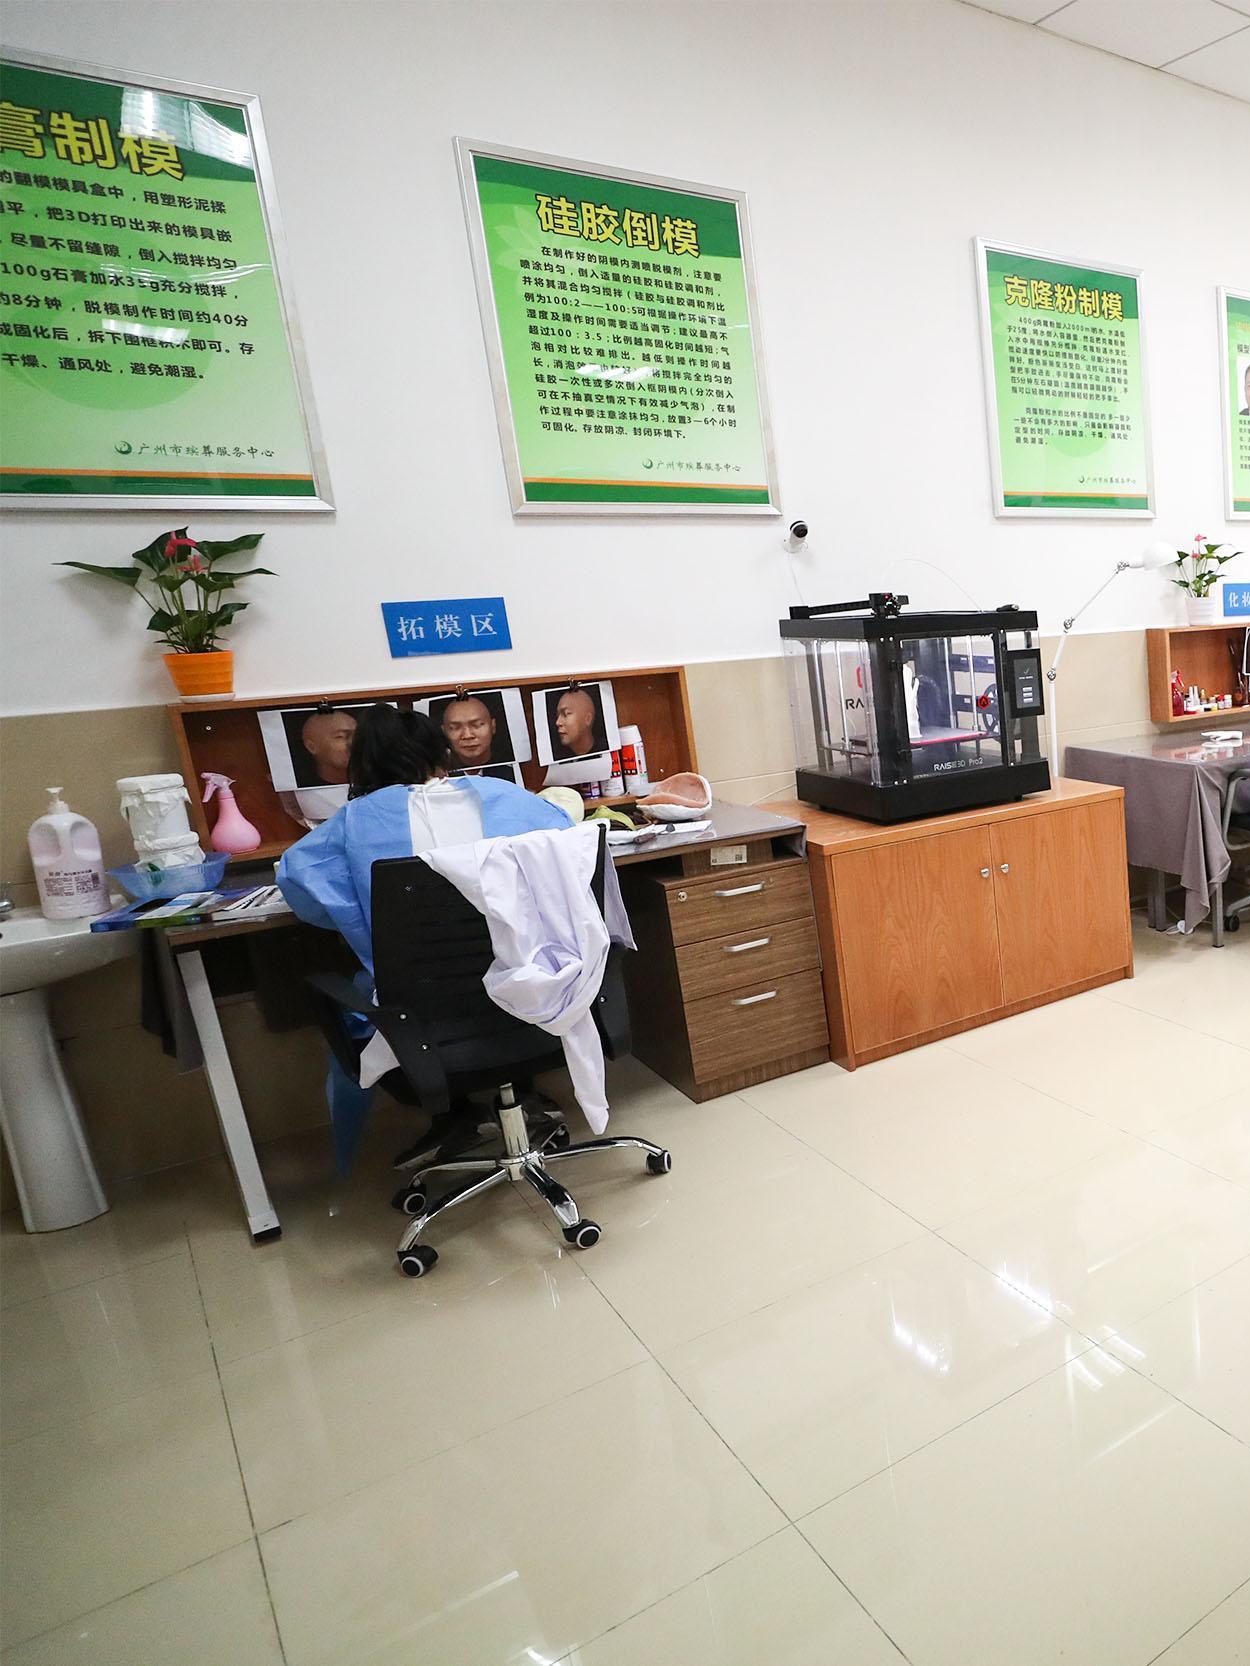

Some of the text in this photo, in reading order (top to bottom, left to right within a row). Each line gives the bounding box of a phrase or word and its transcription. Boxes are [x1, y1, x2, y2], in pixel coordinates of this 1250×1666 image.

[535, 194, 700, 257] 硅胶倒模
[1004, 274, 1124, 321] 克隆粉制模
[397, 612, 497, 641] 拓模区
